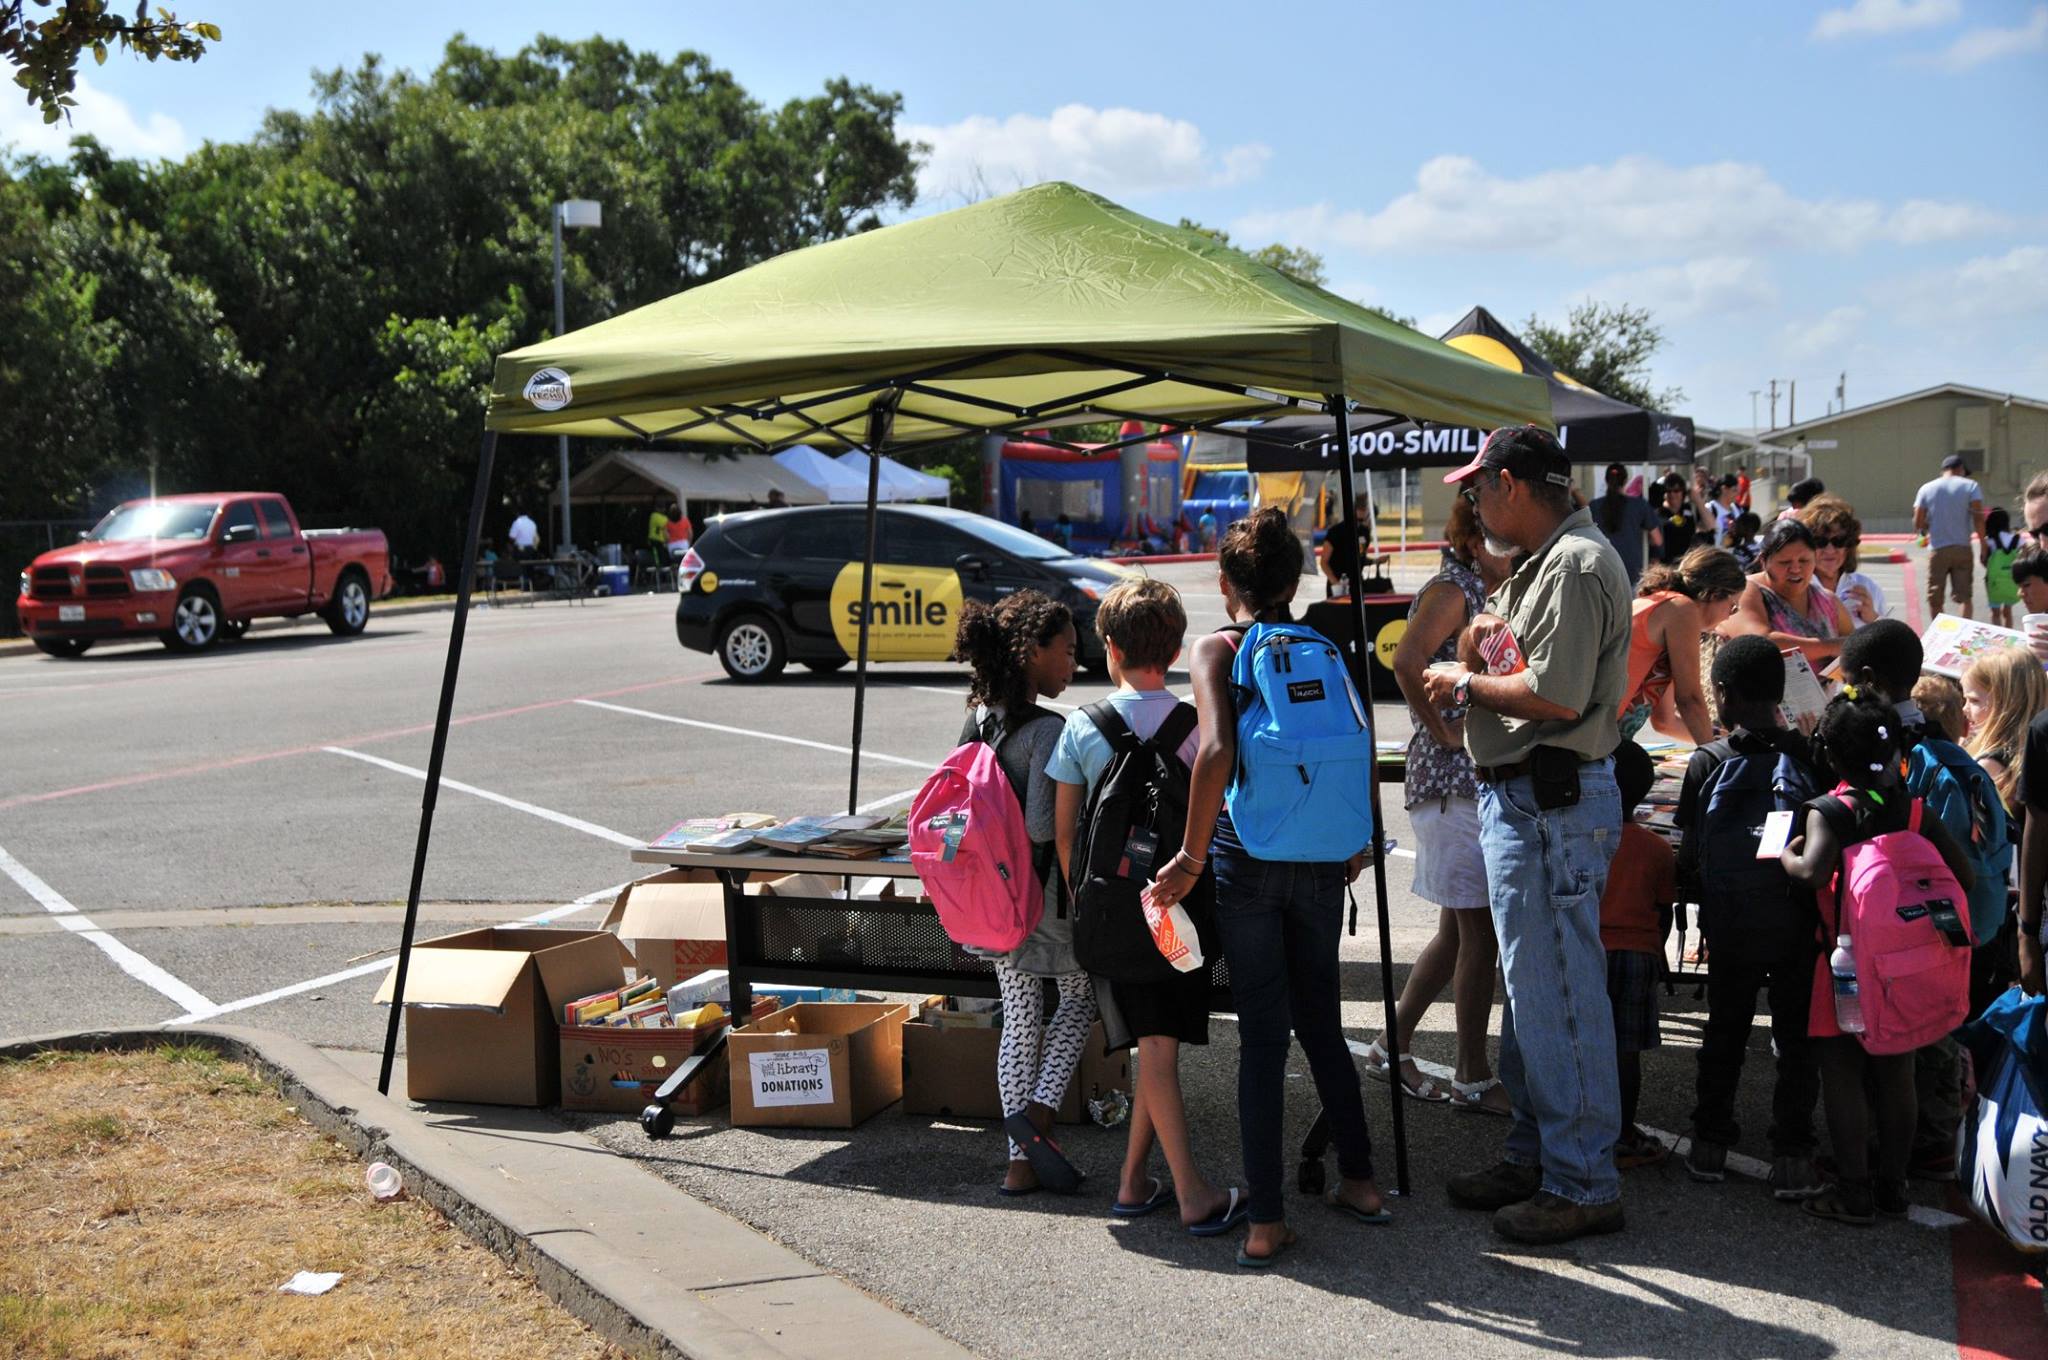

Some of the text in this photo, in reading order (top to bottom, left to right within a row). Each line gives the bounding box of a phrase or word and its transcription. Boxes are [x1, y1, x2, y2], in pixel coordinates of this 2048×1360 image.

[847, 588, 947, 626] smile
[777, 1062, 819, 1076] library
[761, 1078, 824, 1093] DONATIONS
[2029, 1194, 2048, 1242] OLD
